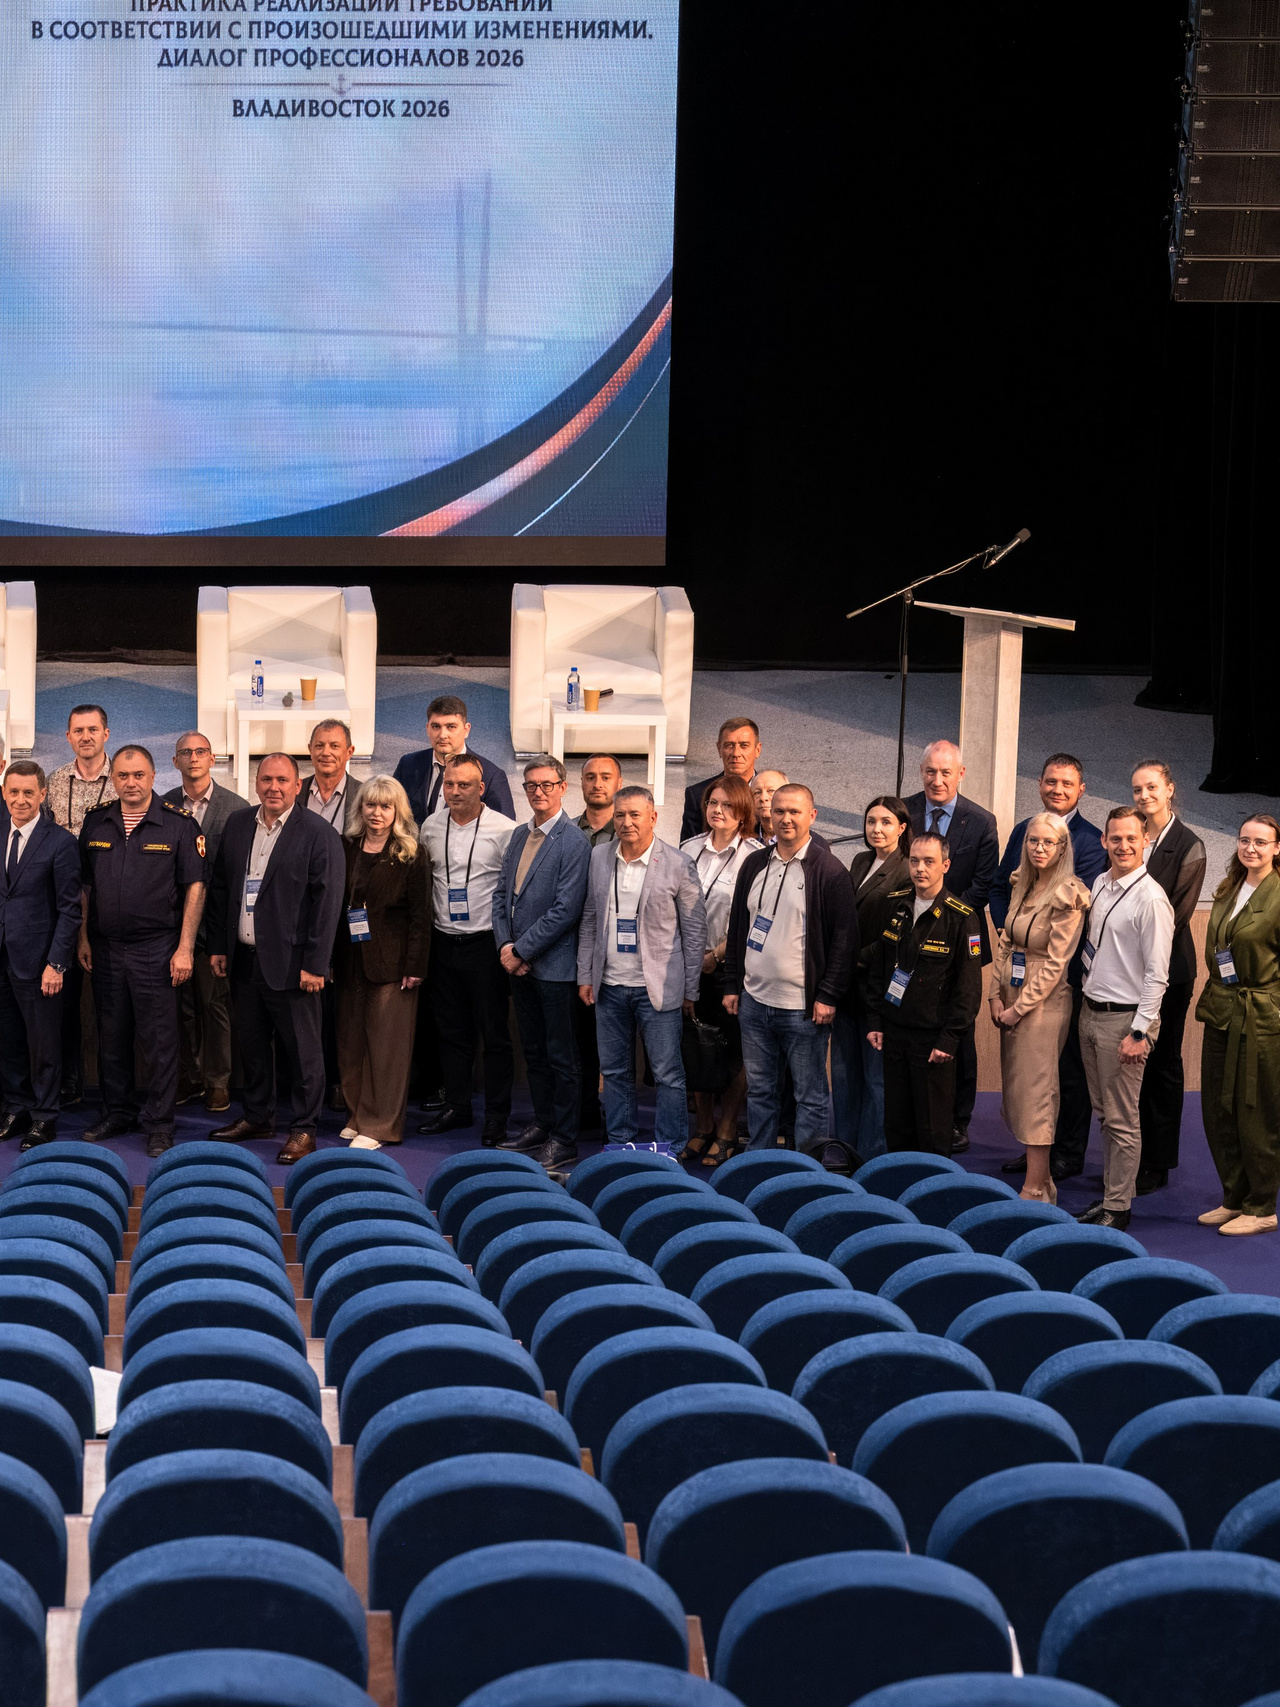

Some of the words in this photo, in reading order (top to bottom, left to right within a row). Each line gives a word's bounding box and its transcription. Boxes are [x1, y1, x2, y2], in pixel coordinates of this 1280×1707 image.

[31, 21, 44, 39] В
[49, 20, 221, 40] СООТВЕТСТВИИ
[228, 20, 242, 40] С
[248, 20, 467, 41] ПРОИЗОШЕДШИМИ
[474, 20, 653, 40] ИЗМЕНЕНИЯМИ.
[157, 49, 247, 68] ДИАЛОГ
[254, 47, 469, 70] ПРОФЕССИОНАЛОВ
[475, 49, 524, 67] 2026
[232, 99, 396, 118] ВЛАДИВОСТОК
[401, 100, 450, 117] 2026
